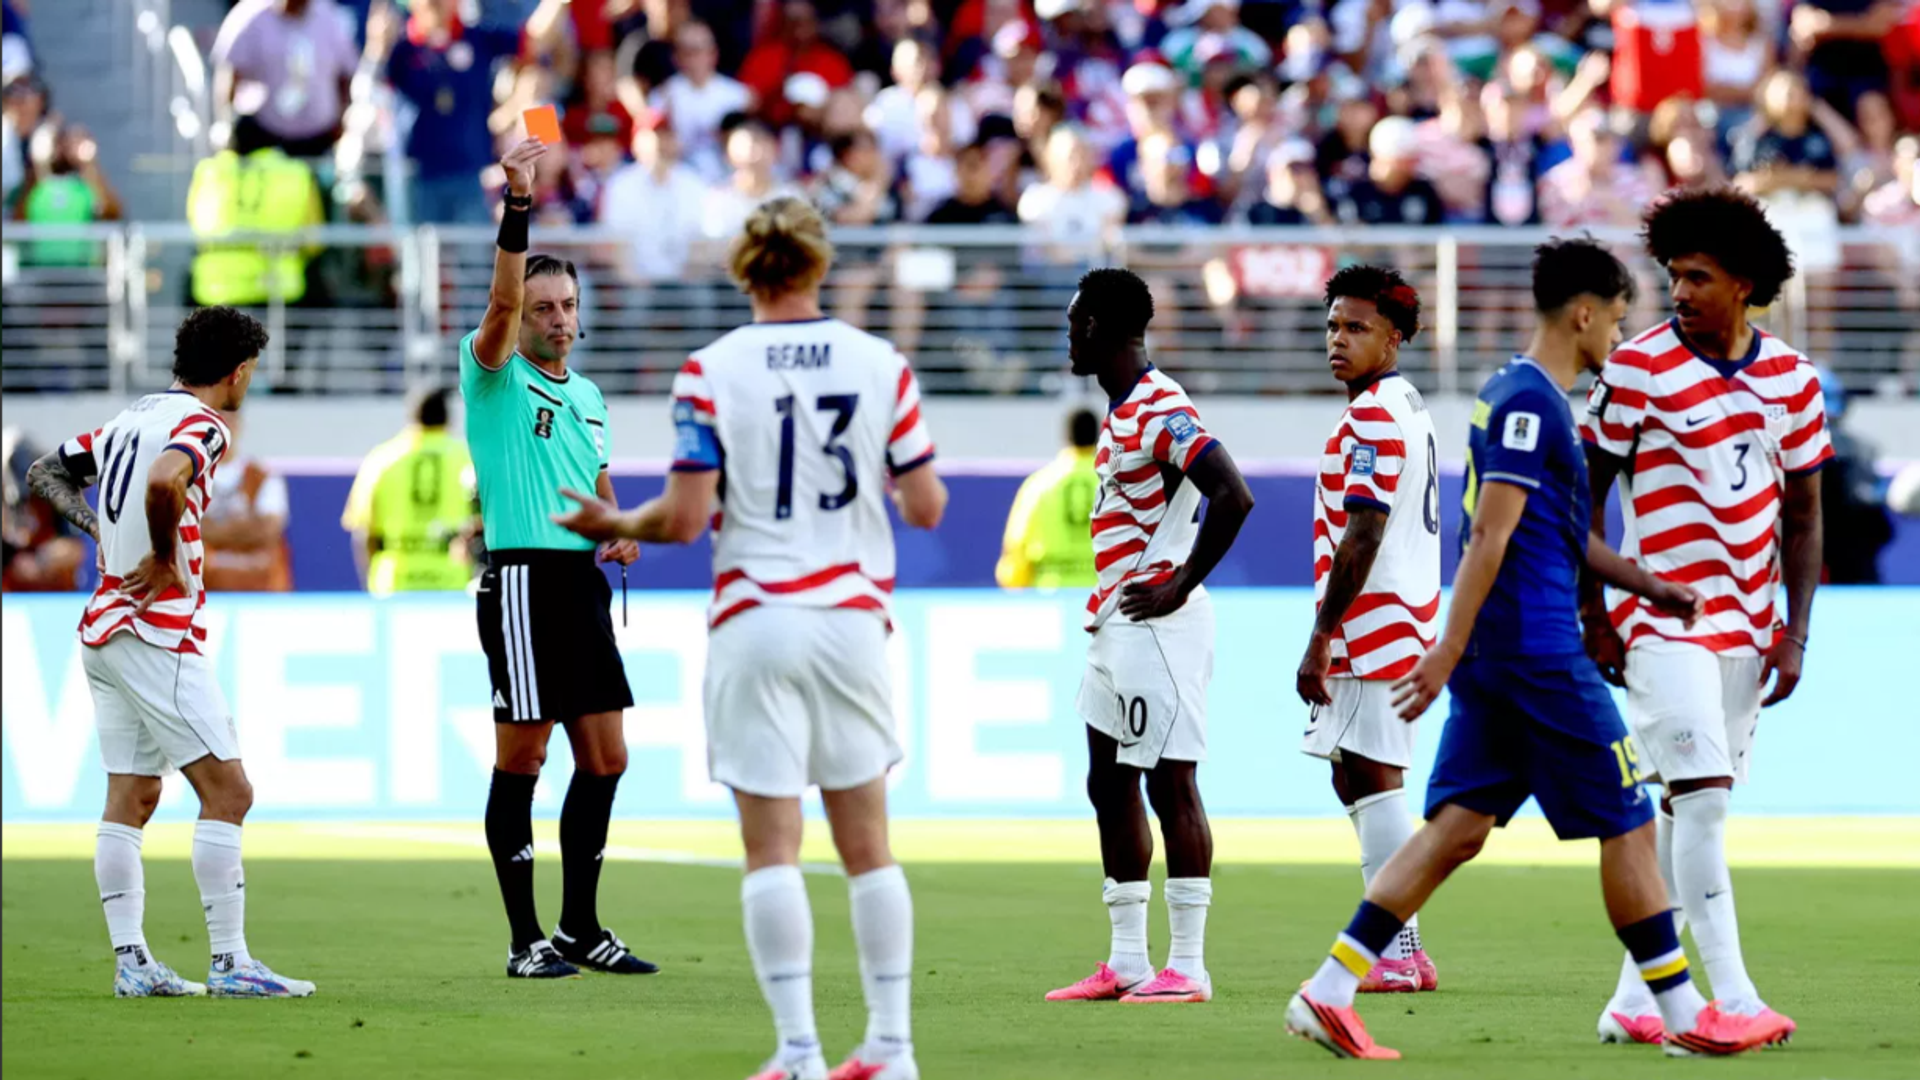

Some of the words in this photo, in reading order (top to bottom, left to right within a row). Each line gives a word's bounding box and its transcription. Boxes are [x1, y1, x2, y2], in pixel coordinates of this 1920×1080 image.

[775, 393, 859, 520] 13
[1731, 443, 1751, 492] 3
[1423, 432, 1438, 535] 8
[1116, 693, 1148, 737] 0
[1610, 735, 1643, 788] 19
